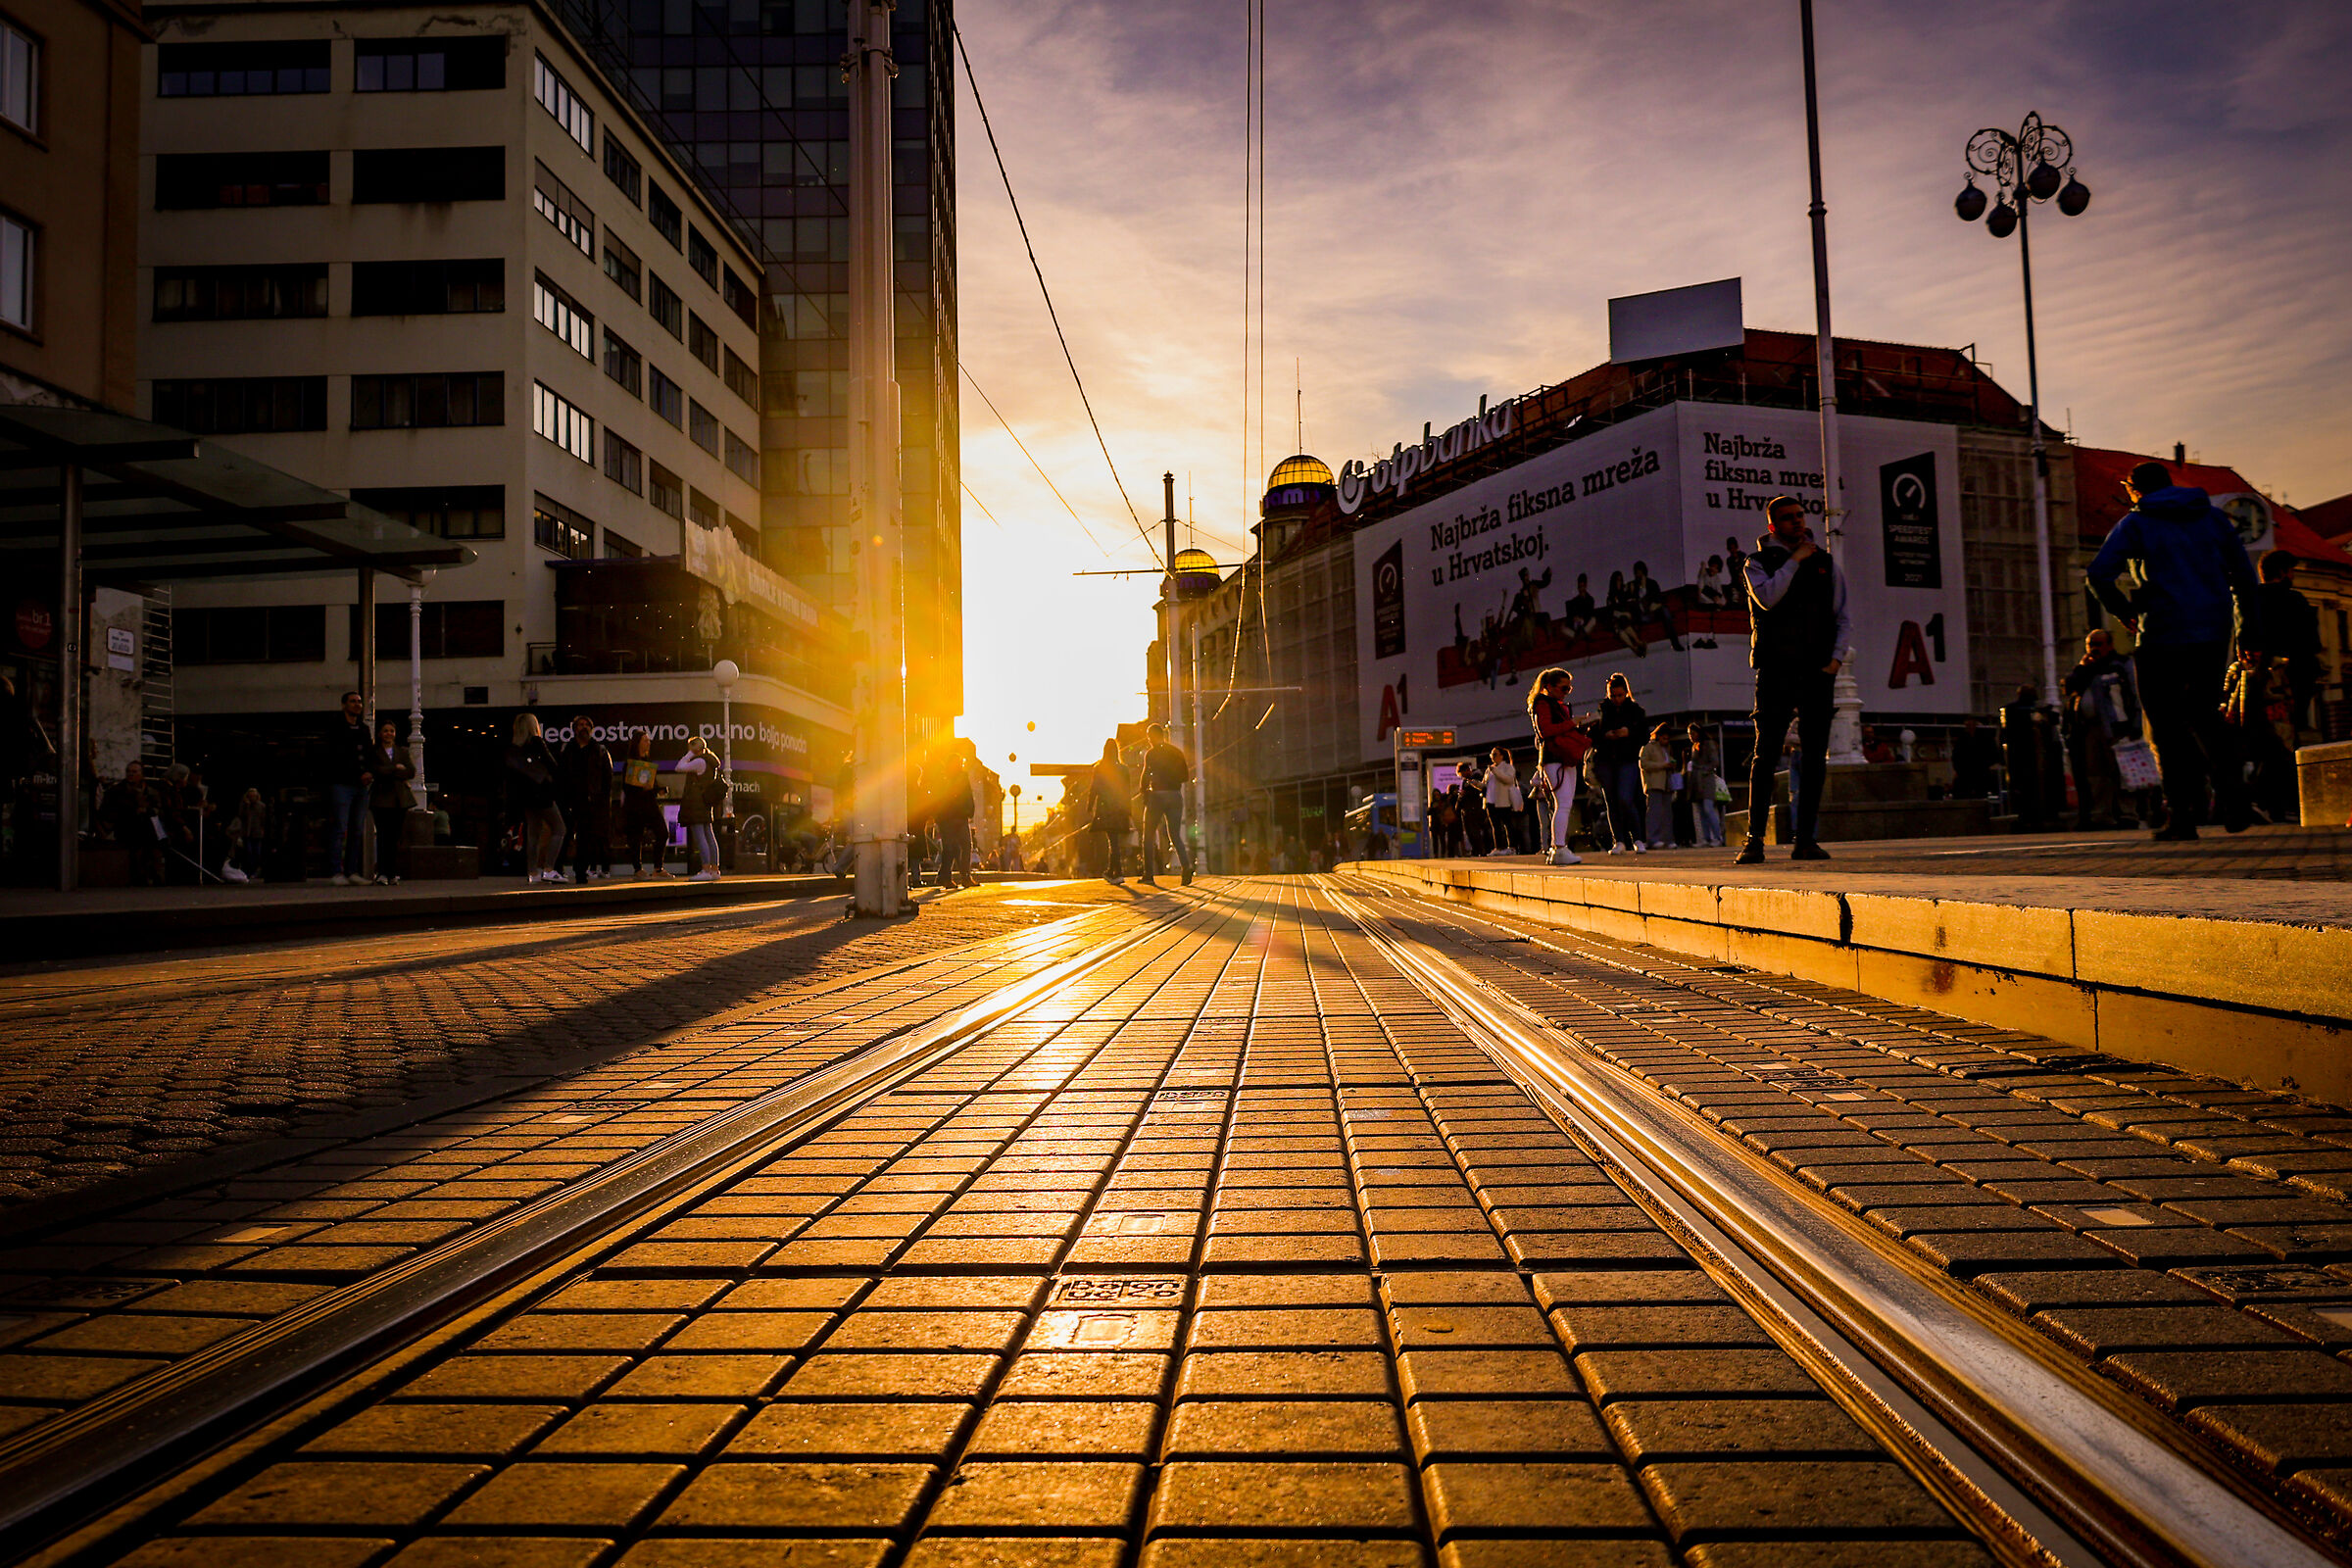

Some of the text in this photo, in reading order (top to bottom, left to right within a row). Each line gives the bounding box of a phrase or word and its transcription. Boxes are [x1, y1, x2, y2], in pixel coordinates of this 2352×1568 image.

[1703, 432, 1786, 461] Najbrža
[1705, 460, 1844, 490] fiksna mre
[1430, 446, 1661, 551] Najbrža fiksna mreža
[1706, 492, 1721, 509] u
[1431, 525, 1550, 586] u Hrvatskoj.
[1887, 612, 1945, 689] A1
[1377, 672, 1408, 742] A1
[699, 722, 756, 742] puno
